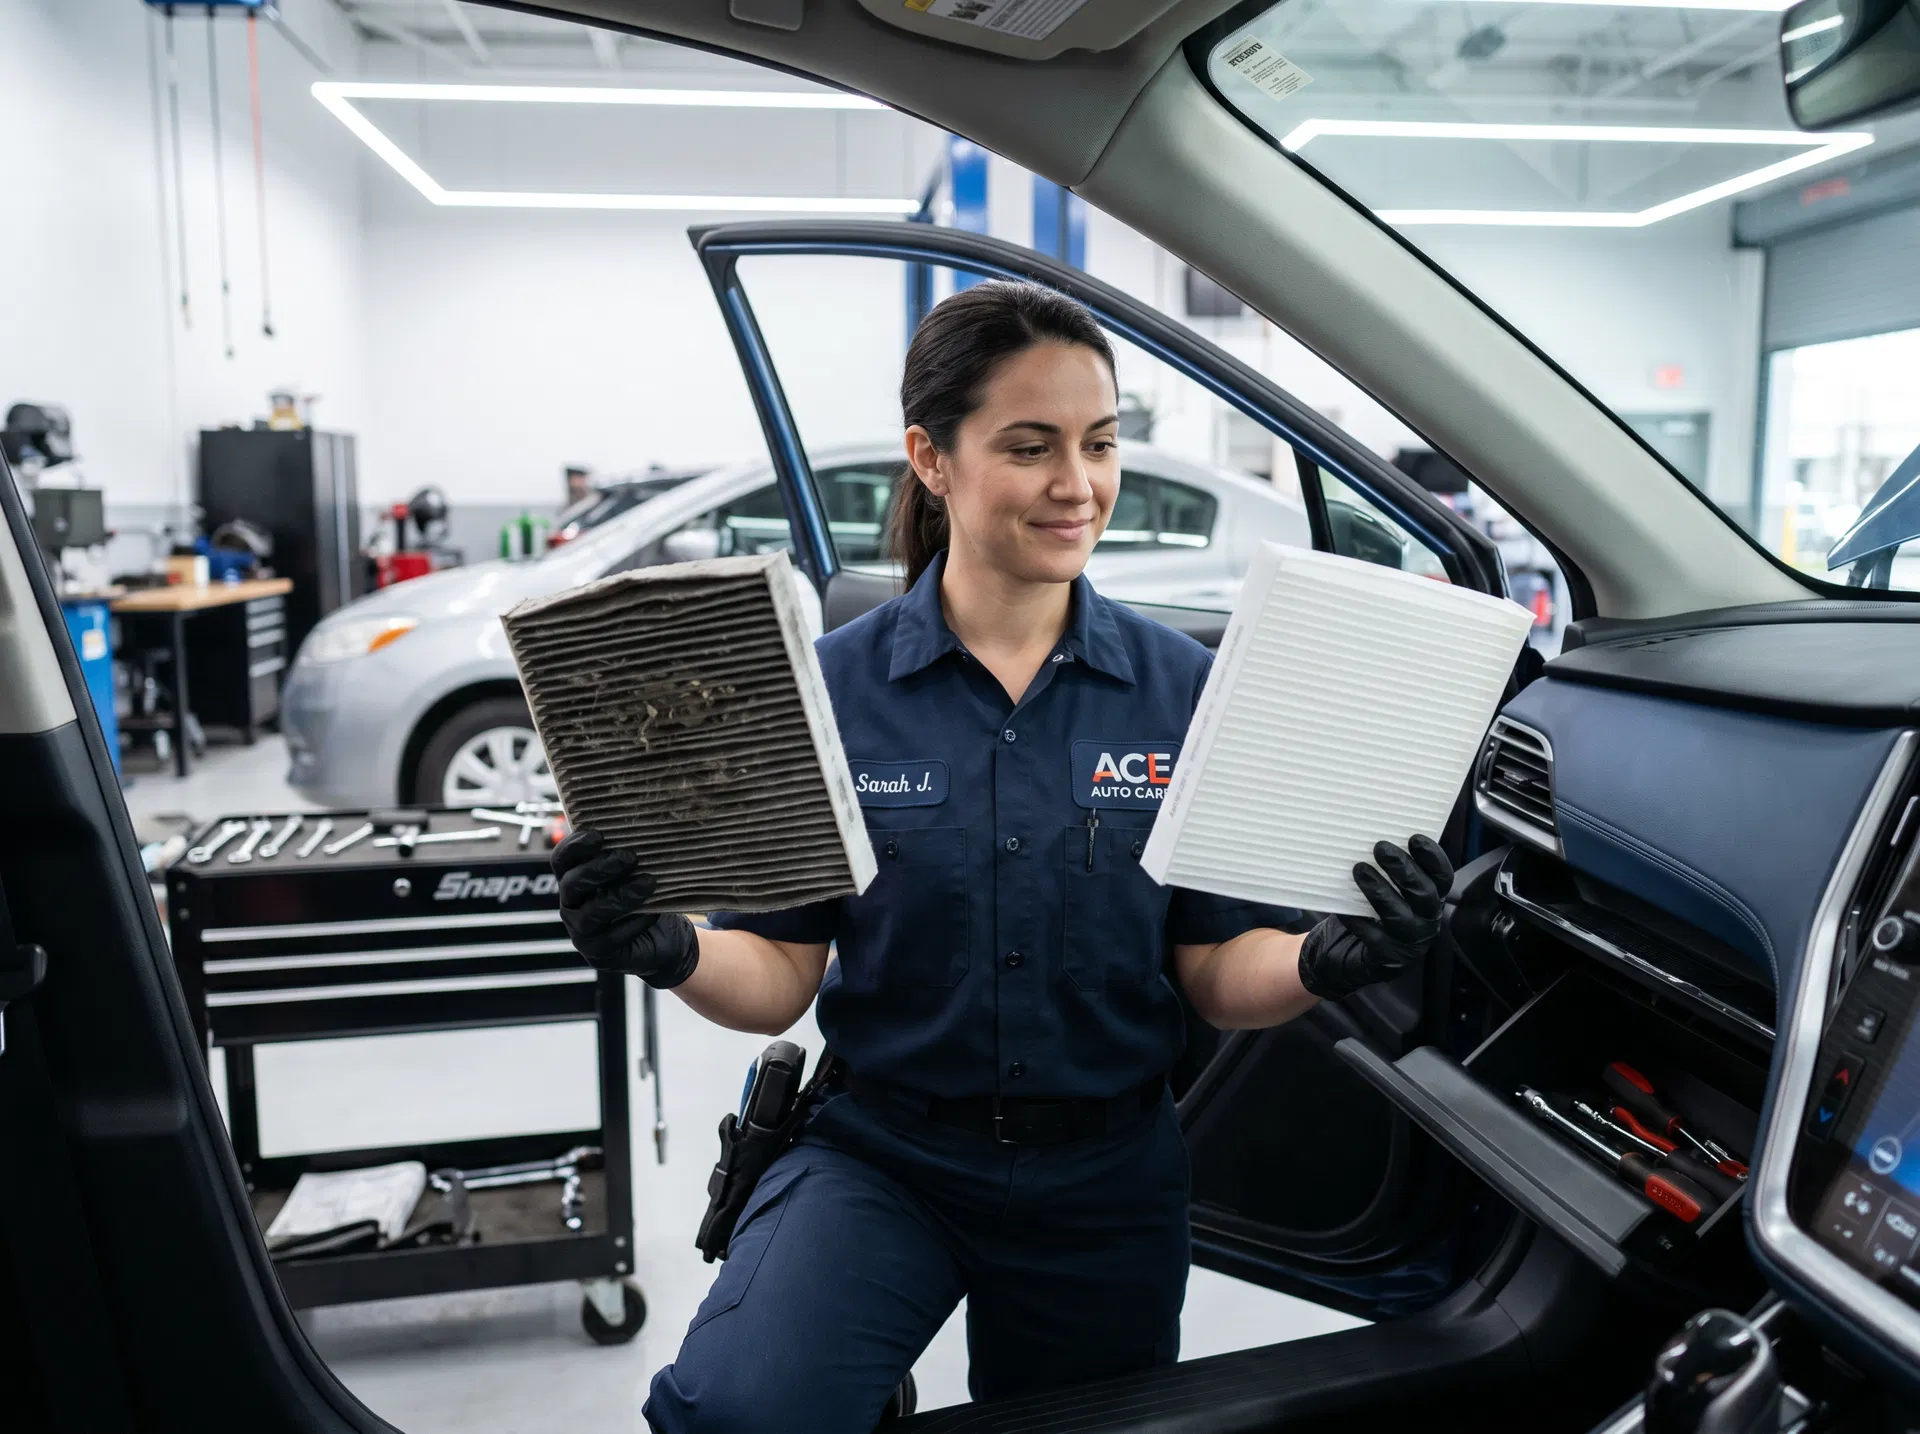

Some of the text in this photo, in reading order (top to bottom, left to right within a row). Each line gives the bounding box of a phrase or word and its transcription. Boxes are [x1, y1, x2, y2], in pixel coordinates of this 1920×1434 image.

[1092, 752, 1171, 784] ACE
[855, 772, 932, 793] Sarah J.
[1091, 786, 1131, 798] AUTO
[432, 871, 560, 903] Snap-o
